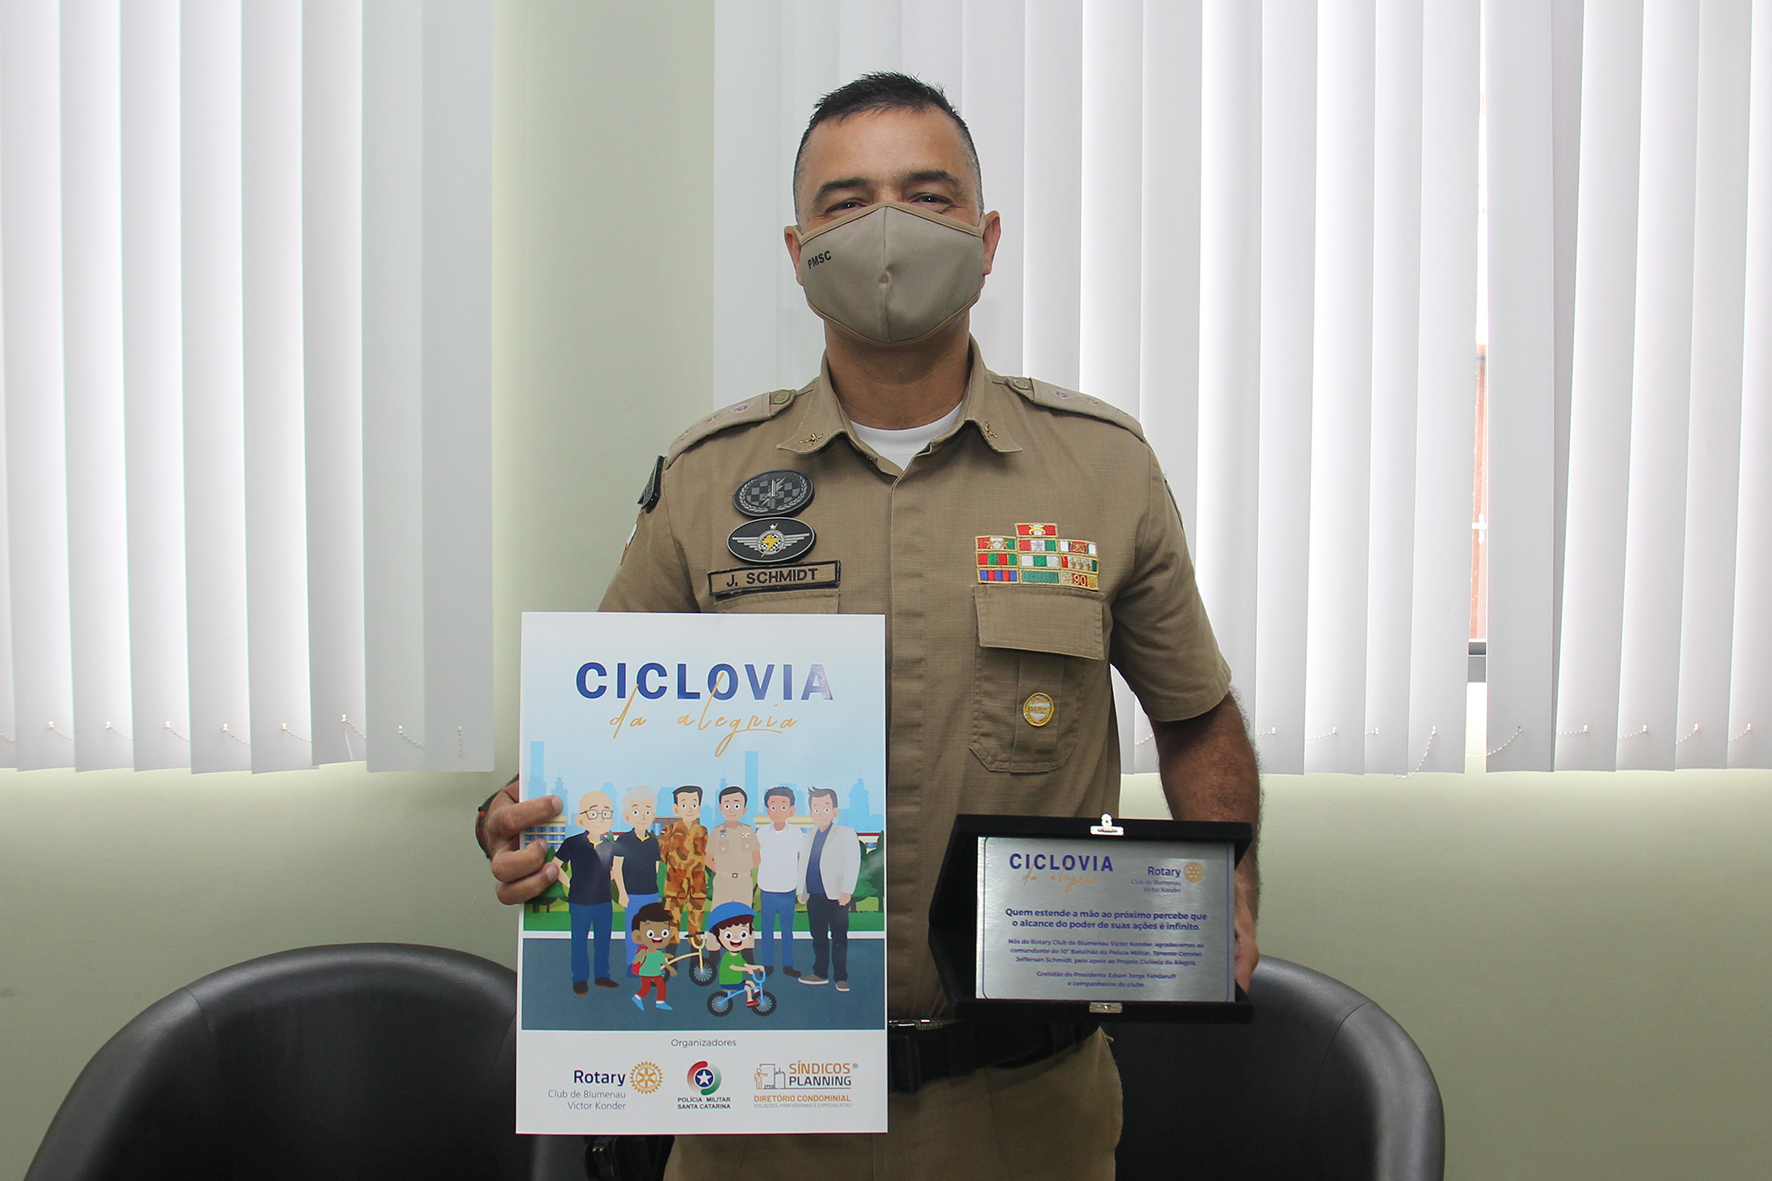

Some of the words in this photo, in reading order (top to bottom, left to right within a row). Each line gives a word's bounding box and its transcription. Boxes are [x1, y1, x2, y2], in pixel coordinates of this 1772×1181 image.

[807, 250, 832, 270] PMSC
[726, 574, 739, 588] J.
[746, 568, 818, 585] SCHMIDT
[575, 661, 834, 701] CICLOVIA
[609, 684, 647, 739] da
[677, 672, 797, 757] alegria
[1009, 853, 1114, 872] CICLOVIA
[1147, 866, 1182, 878] Rotary
[1005, 908, 1033, 917] Quem
[1035, 909, 1071, 917] estende
[1080, 909, 1100, 918] mão
[1114, 910, 1152, 921] próximo
[1153, 911, 1190, 921] percebe
[1191, 914, 1208, 922] que
[1020, 919, 1055, 928] alcance
[1056, 919, 1069, 929] do
[1070, 920, 1096, 930] poder
[1098, 921, 1110, 929] de
[1111, 922, 1131, 930] suas
[1132, 921, 1158, 932] ações
[1159, 922, 1166, 931] é
[1167, 921, 1201, 931] infinito.
[1031, 939, 1052, 947] Rotary
[1155, 942, 1196, 950] agradecemos
[1071, 948, 1099, 956] Batalhão
[1117, 958, 1140, 966] Projeto
[671, 1038, 737, 1048] Organizadores
[789, 1060, 851, 1075] SÍNDICOS
[573, 1069, 627, 1087] Rotary
[789, 1076, 852, 1087] PLANNING
[548, 1089, 568, 1099] Club
[571, 1089, 581, 1099] de
[584, 1089, 626, 1099] Blumenau
[754, 1094, 796, 1102] DIRETÓRIO
[568, 1101, 593, 1110] Victor
[595, 1101, 626, 1110] Konder
